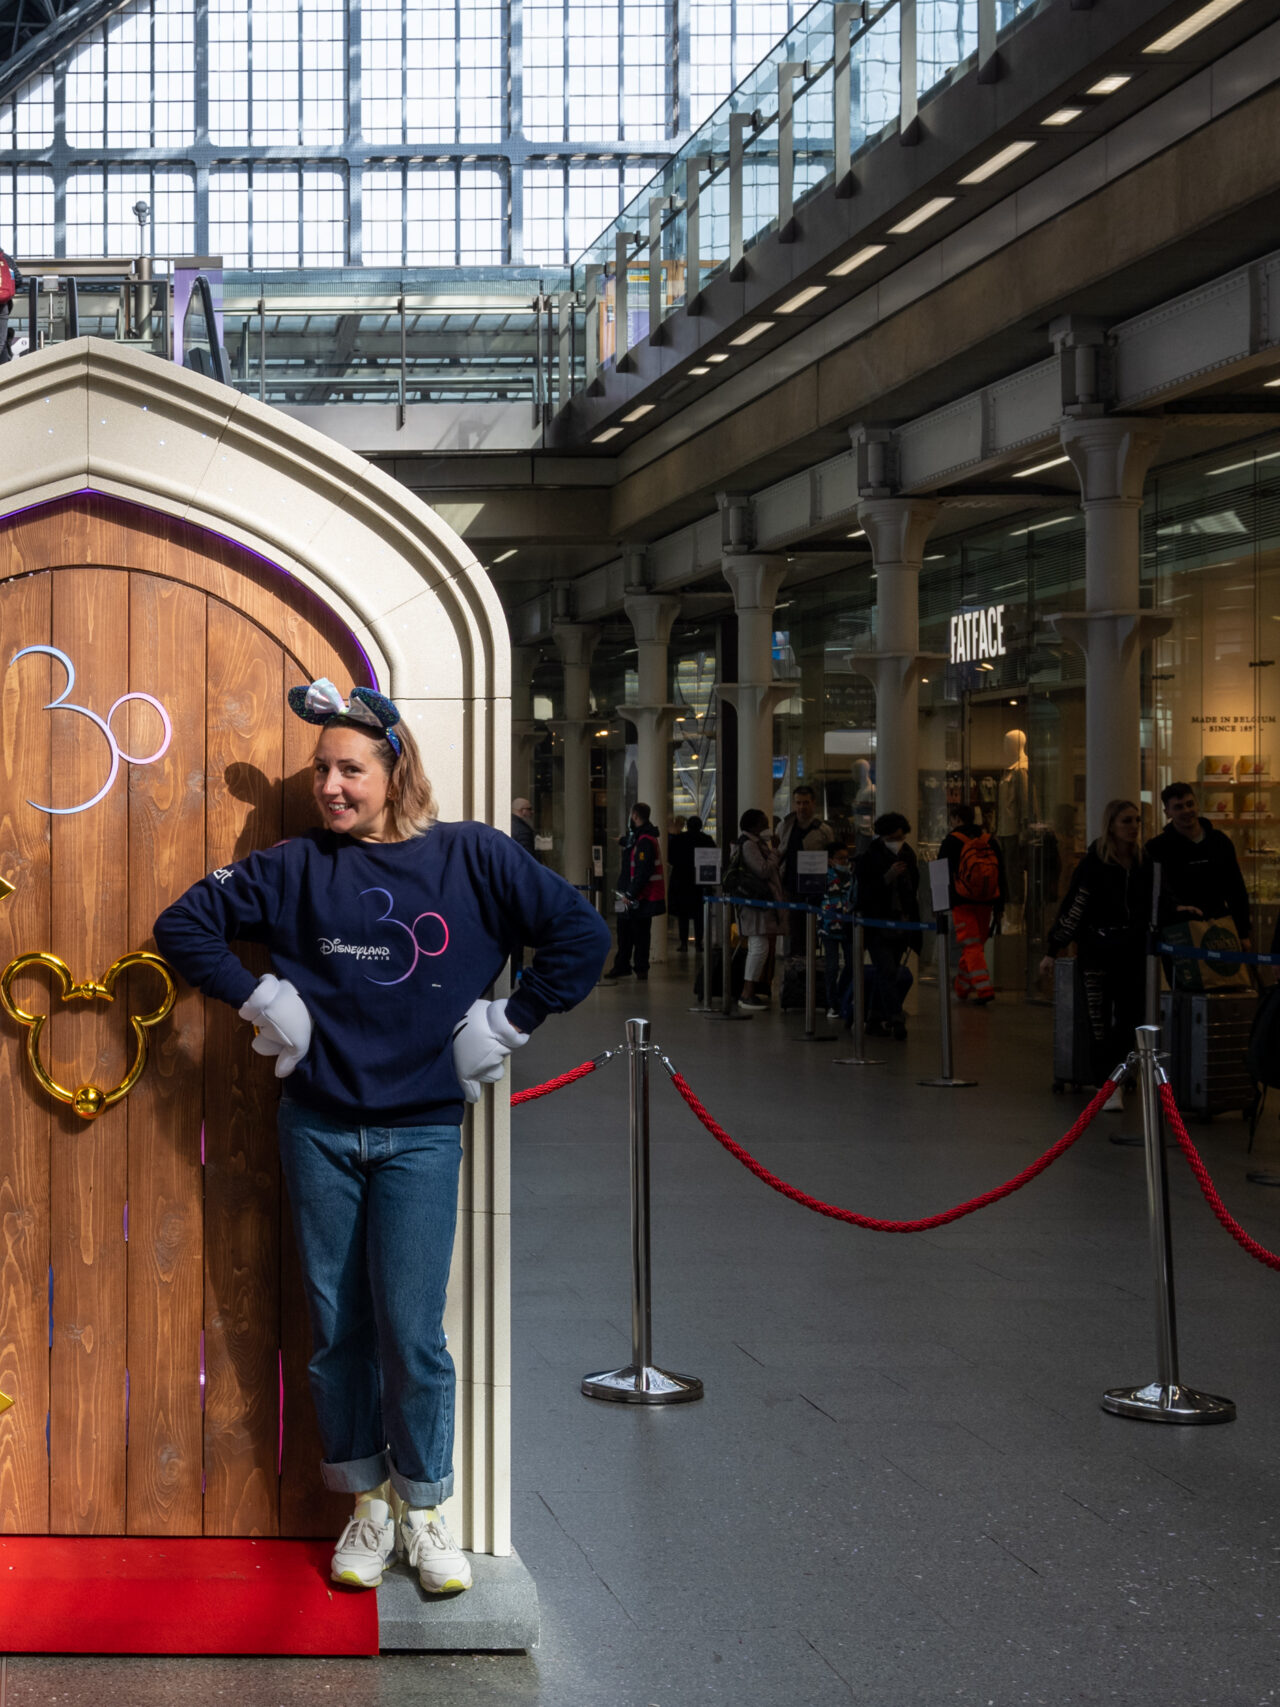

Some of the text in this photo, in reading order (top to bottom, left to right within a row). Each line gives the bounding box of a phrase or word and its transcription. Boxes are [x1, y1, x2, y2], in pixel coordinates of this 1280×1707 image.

[950, 604, 1007, 665] FATFACE
[1191, 716, 1277, 724] MADE IN BELGIUM
